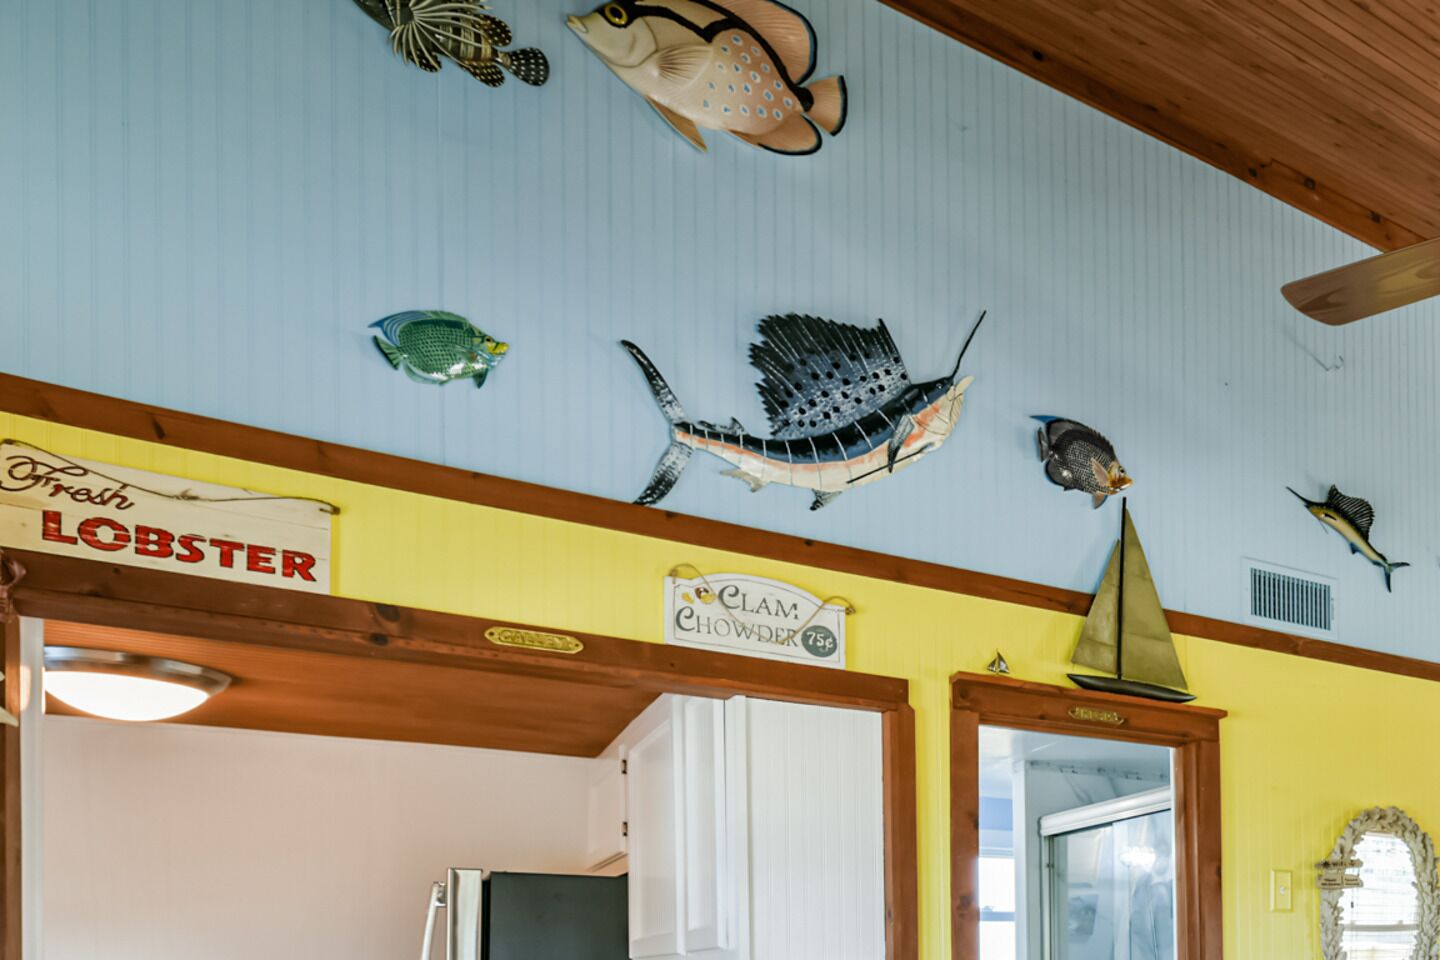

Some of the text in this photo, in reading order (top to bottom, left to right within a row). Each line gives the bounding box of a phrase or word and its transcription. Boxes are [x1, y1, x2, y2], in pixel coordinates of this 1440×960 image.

[0, 455, 135, 511] Fresh
[42, 510, 317, 582] LOBSTER
[718, 584, 799, 620] CLAM
[675, 605, 799, 648] CHOWDER
[806, 631, 834, 654] 75¢
